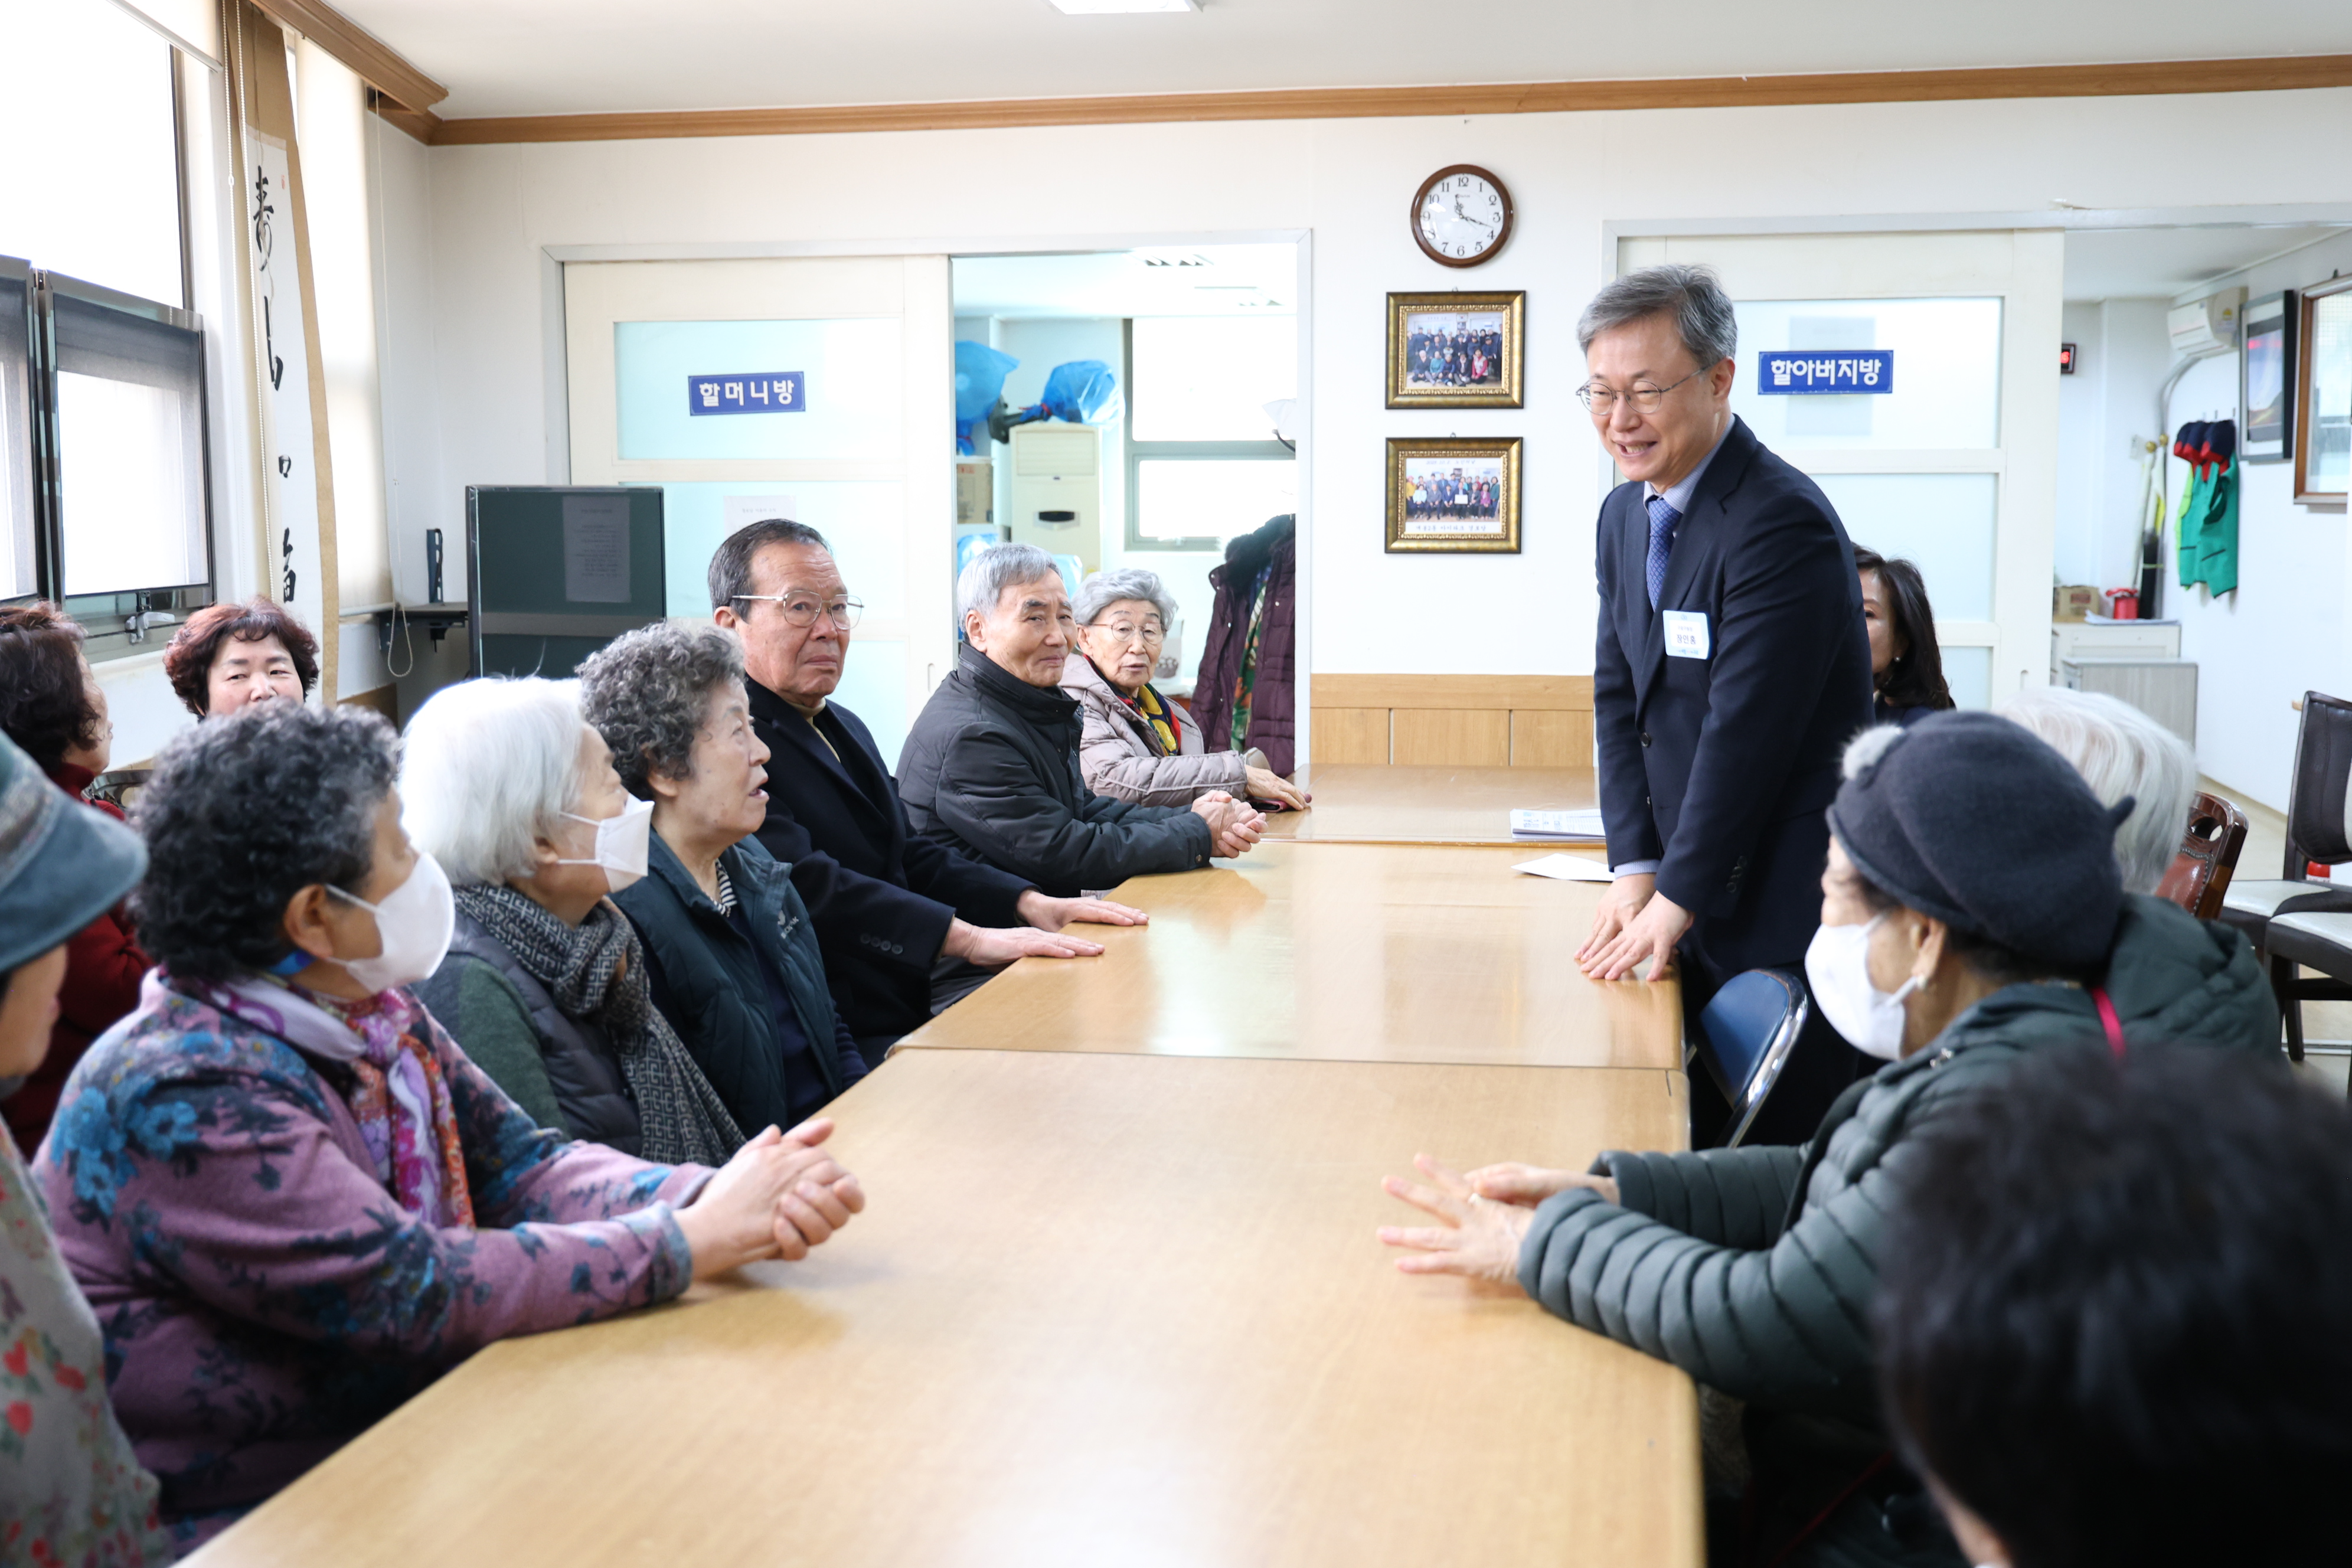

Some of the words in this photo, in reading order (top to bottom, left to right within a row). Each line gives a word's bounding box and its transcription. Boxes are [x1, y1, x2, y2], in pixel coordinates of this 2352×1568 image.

[1442, 182, 1449, 192] 11
[1458, 177, 1469, 187] 12
[1479, 182, 1482, 192] 1
[1429, 194, 1439, 204] 10
[1489, 195, 1497, 205] 2
[1423, 211, 1430, 221] 9
[1493, 213, 1501, 223] 3
[1487, 230, 1495, 240] 4
[1441, 242, 1448, 253] 7
[1457, 246, 1465, 256] 6
[1475, 241, 1482, 253] 5
[1770, 358, 1882, 386] 할아버지방
[699, 380, 795, 407] 할머니방
[1677, 634, 1696, 645] 장인홍
